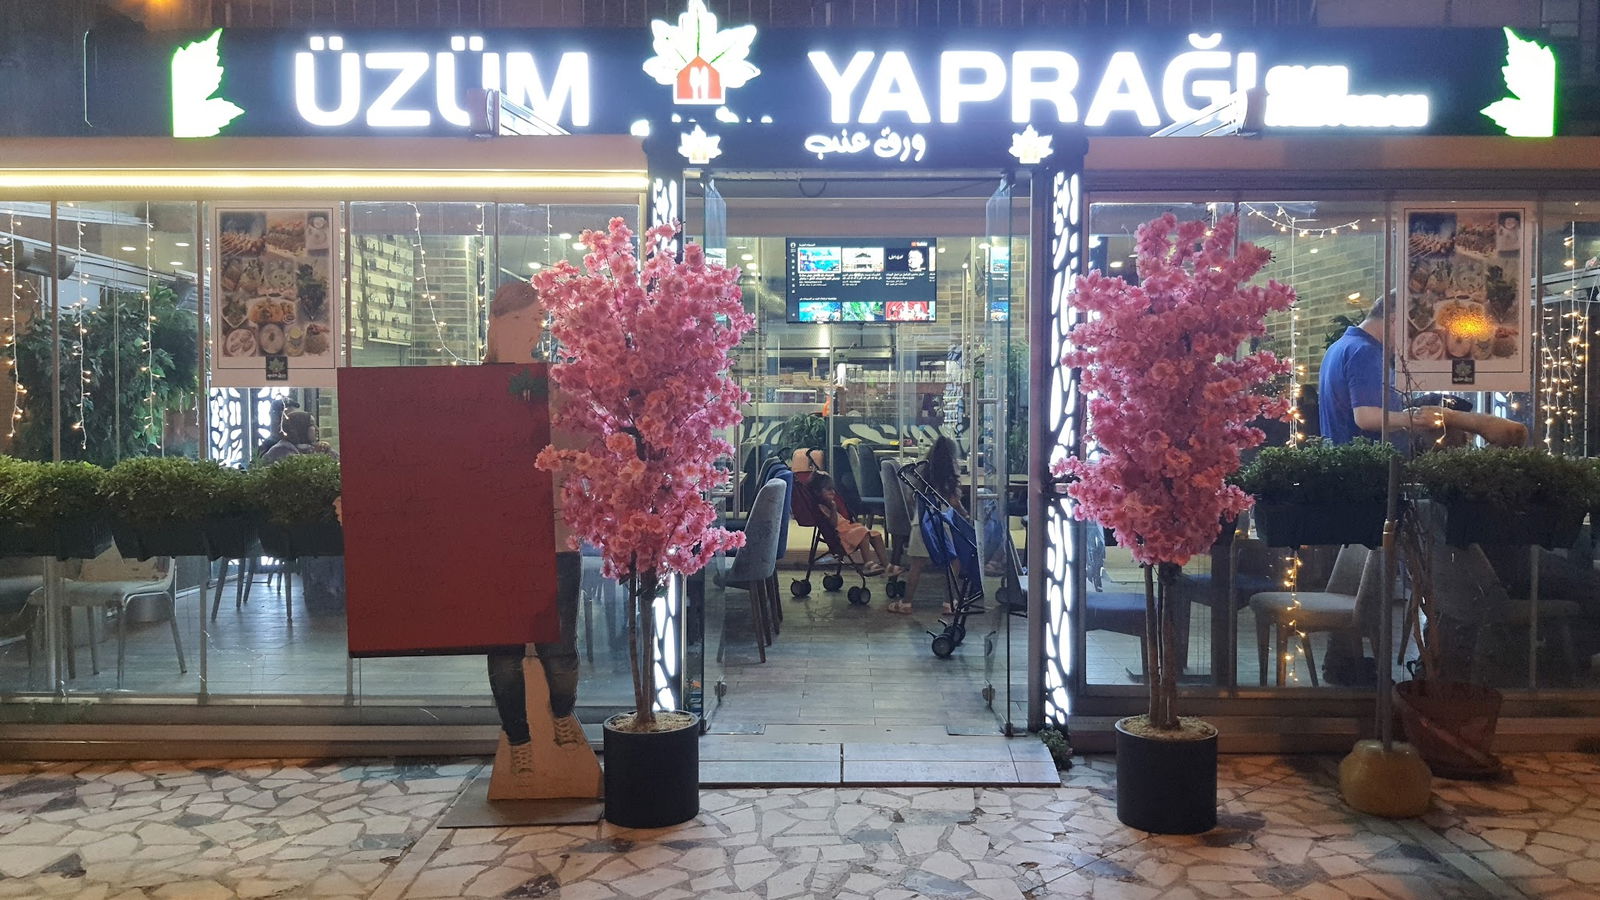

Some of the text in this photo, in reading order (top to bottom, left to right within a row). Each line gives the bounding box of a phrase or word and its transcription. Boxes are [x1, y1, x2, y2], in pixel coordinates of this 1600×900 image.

[295, 35, 590, 127] ÜZÜM
[804, 126, 926, 162] ورق عنب
